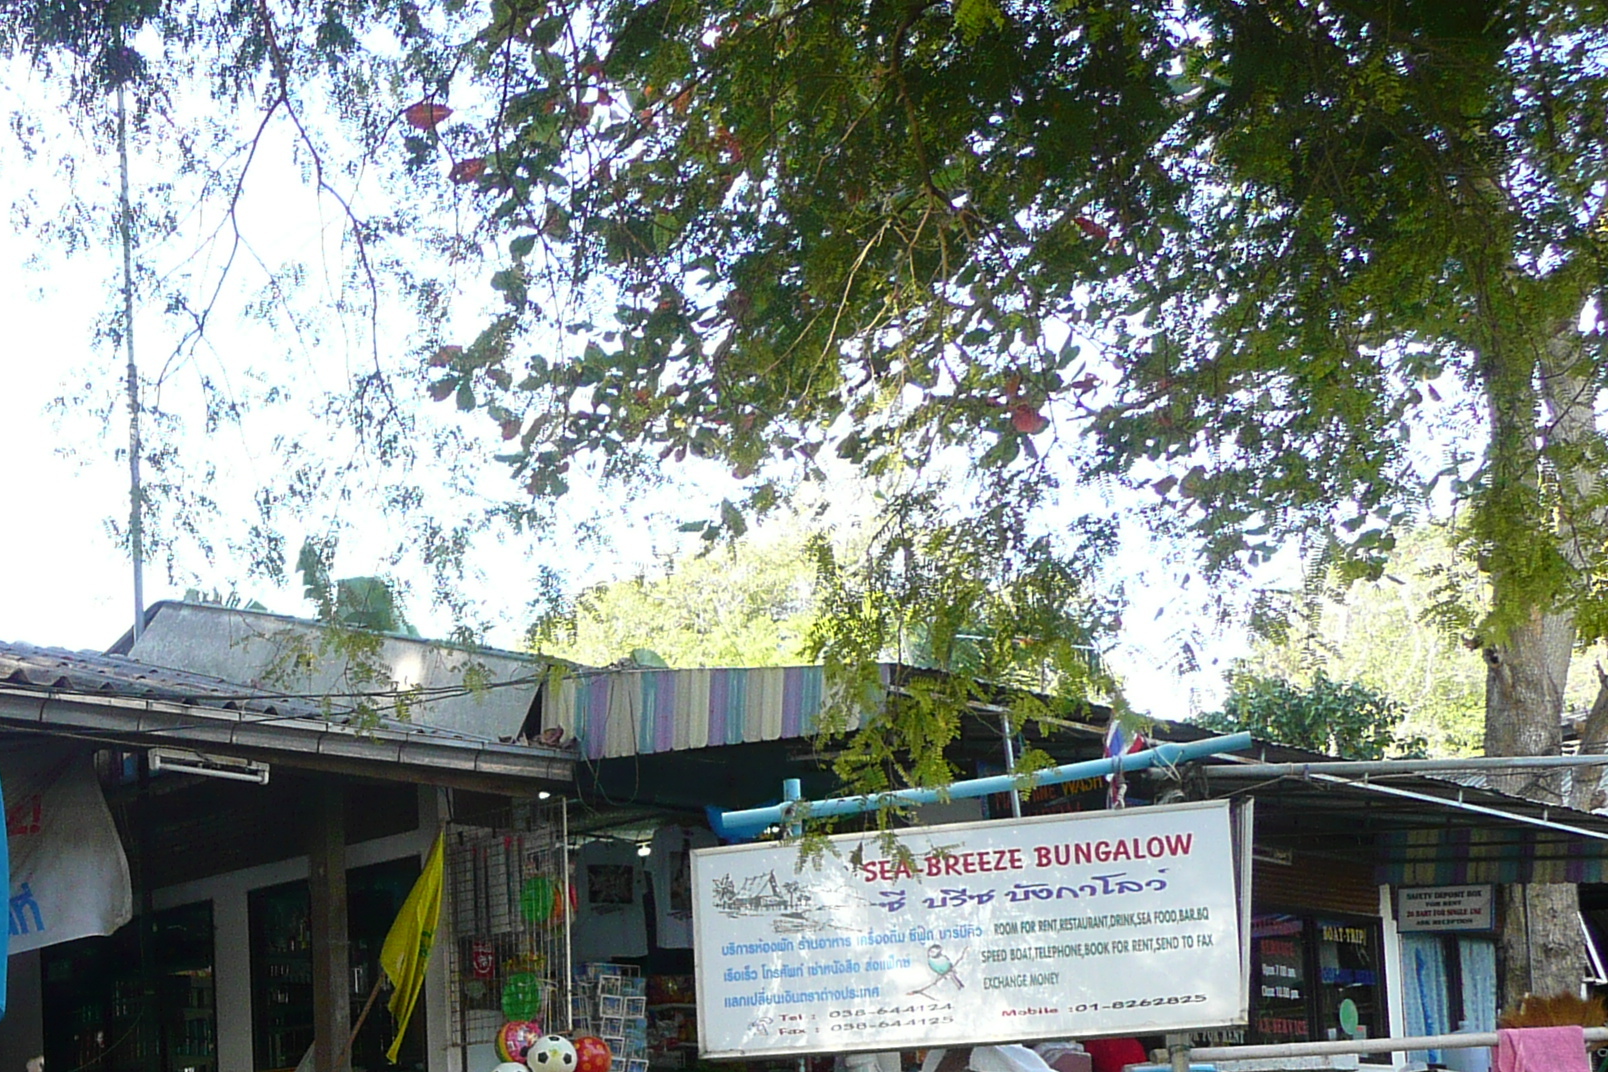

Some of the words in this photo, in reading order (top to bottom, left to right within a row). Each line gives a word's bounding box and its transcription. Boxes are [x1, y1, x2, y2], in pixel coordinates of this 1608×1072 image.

[863, 848, 1024, 882] SEA-BREEZE
[1033, 833, 1193, 868] BUNGALOW
[1004, 867, 1171, 903] บังกาโลว์
[1406, 892, 1432, 900] SAFETY
[1434, 891, 1465, 899] DEPOSIT
[1433, 909, 1445, 917] FOR
[993, 922, 1020, 936] ROOM
[1020, 920, 1037, 934] FOR
[981, 948, 1007, 963] SPEED
[1111, 940, 1130, 954] FOR
[1132, 936, 1180, 953] RENT,SEND
[1181, 935, 1194, 948] TO
[1196, 933, 1214, 948] FAX
[983, 973, 1028, 990] EXCHANGE
[1029, 971, 1060, 987] MONEY
[778, 1013, 803, 1022] Tel
[828, 1003, 953, 1019] 038-644124
[1001, 1007, 1059, 1017] Mobile
[778, 1027, 806, 1036] Fax
[830, 1016, 955, 1033] 038-644125
